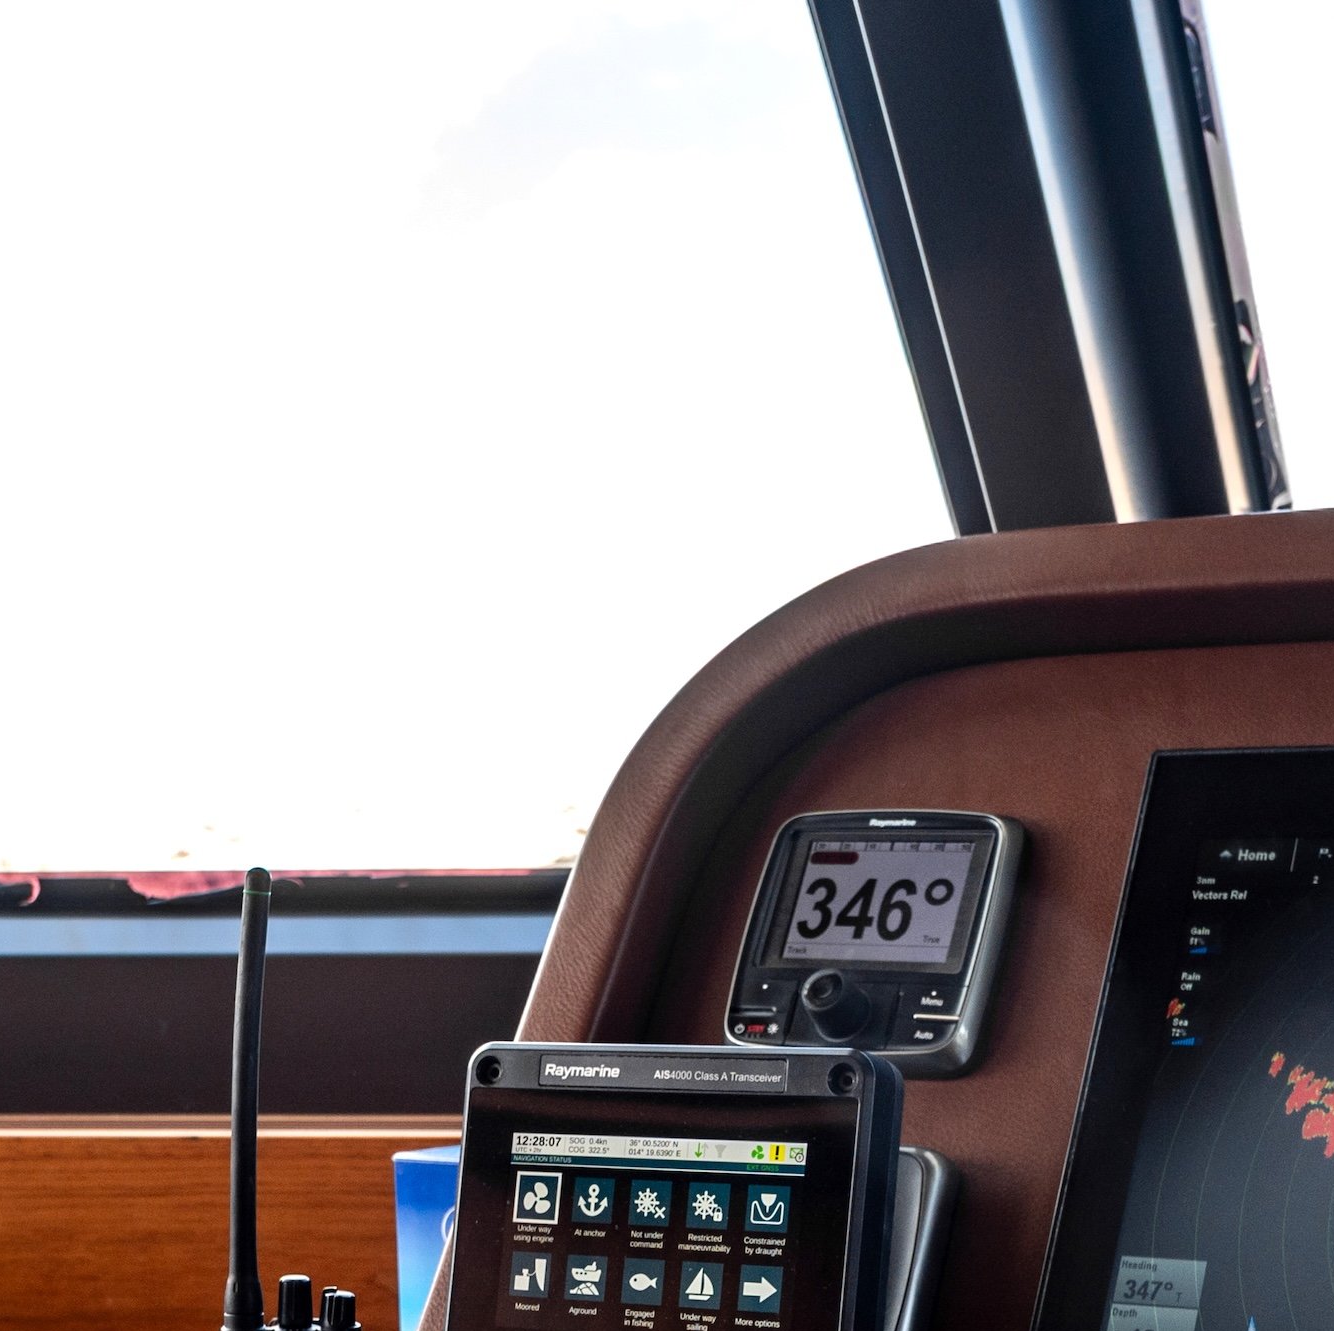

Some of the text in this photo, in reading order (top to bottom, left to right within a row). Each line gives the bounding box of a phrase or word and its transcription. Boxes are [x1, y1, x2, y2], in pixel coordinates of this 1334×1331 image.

[869, 819, 916, 828] Raymarine
[1237, 849, 1276, 862] Home
[1192, 890, 1247, 900] Vectors Rel
[1190, 926, 1211, 936] Gain
[1180, 972, 1201, 981] Rain
[921, 997, 943, 1007] Menu
[1172, 1018, 1188, 1027] Sea
[914, 1030, 934, 1040] Auto
[544, 1063, 620, 1079] Raymarine
[653, 1069, 782, 1083] AIS4000 Class A Transceiver
[516, 1135, 562, 1148] 12:28:07
[569, 1137, 586, 1145] SOG
[568, 1146, 585, 1154] COG
[513, 1155, 548, 1163] NAVIGATION
[517, 1224, 552, 1235] Under way
[574, 1229, 606, 1238] At anchor
[631, 1230, 664, 1239] Not under
[513, 1234, 554, 1244] using engine
[687, 1233, 723, 1243] Restricted
[743, 1236, 786, 1246] Constrained
[629, 1240, 663, 1249] command
[677, 1242, 731, 1254] manoeuvrability
[745, 1246, 783, 1256] by draught
[1121, 1260, 1158, 1273] Heading
[515, 1302, 540, 1311] Moored
[569, 1306, 597, 1316] Aground
[625, 1309, 655, 1319] Engaged
[679, 1312, 716, 1324] Under way
[624, 1318, 654, 1329] in fishing
[735, 1317, 780, 1329] More options
